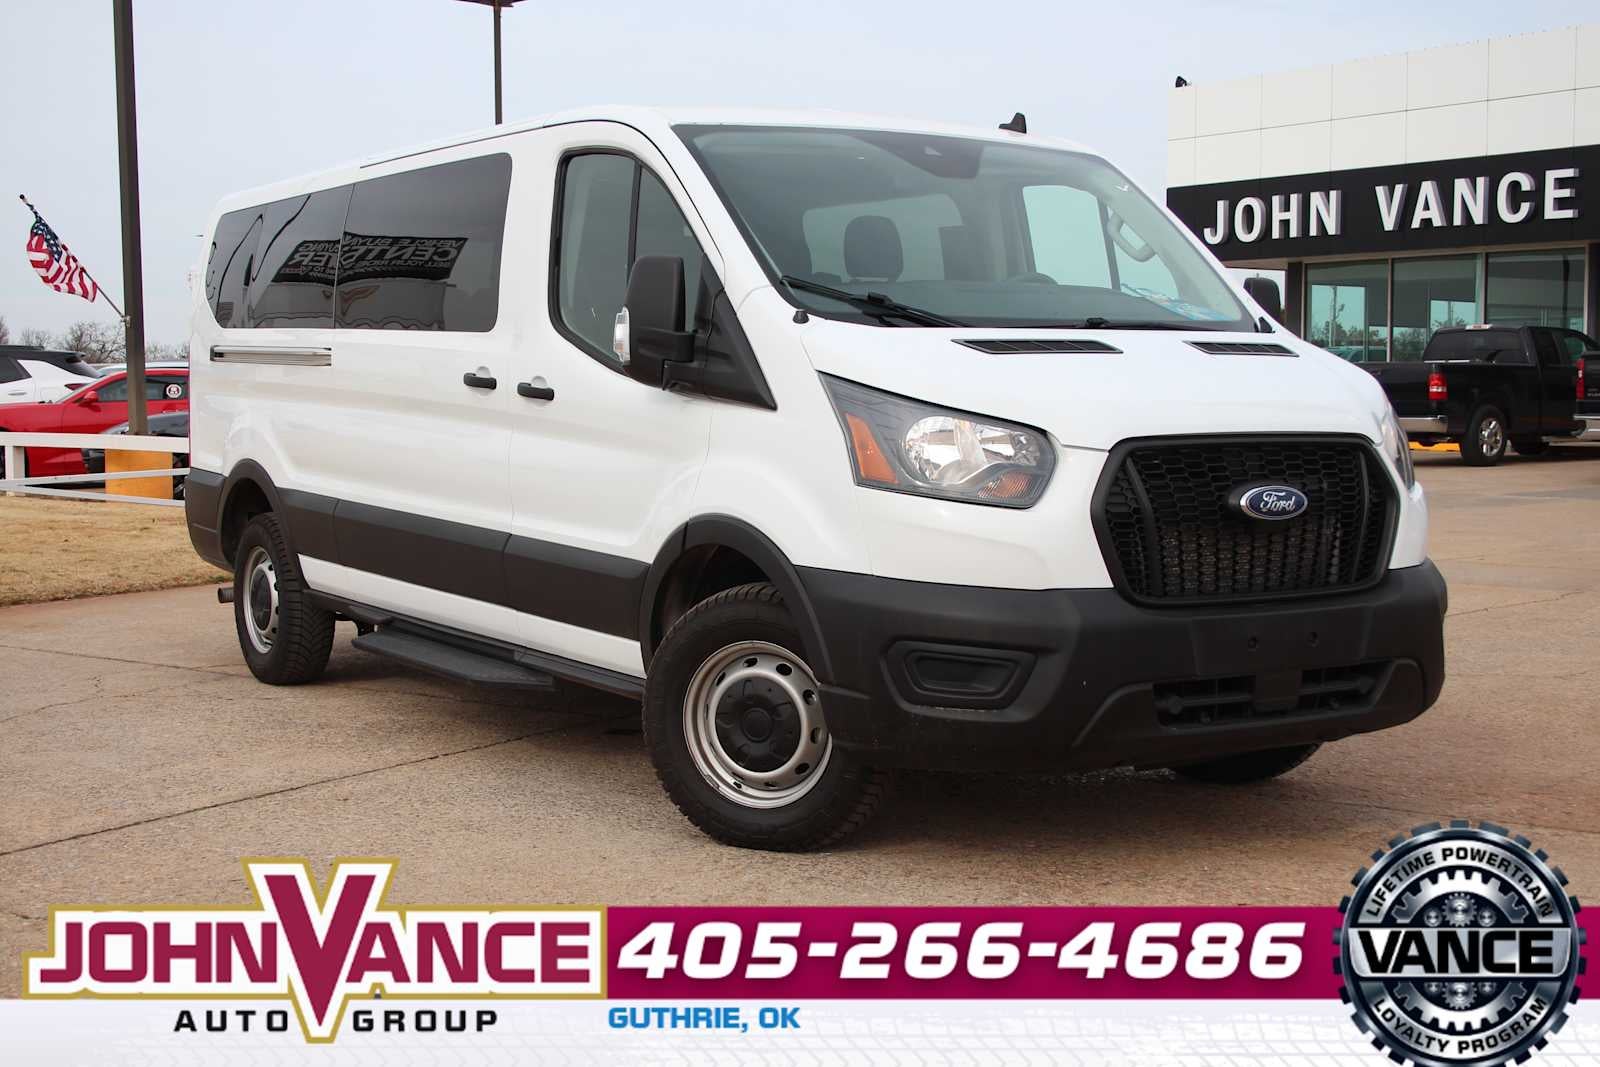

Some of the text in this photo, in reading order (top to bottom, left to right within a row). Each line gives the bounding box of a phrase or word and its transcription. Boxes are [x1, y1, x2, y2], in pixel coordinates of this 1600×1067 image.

[1203, 168, 1580, 246] JOHN VANCE
[1259, 490, 1296, 512] Ford
